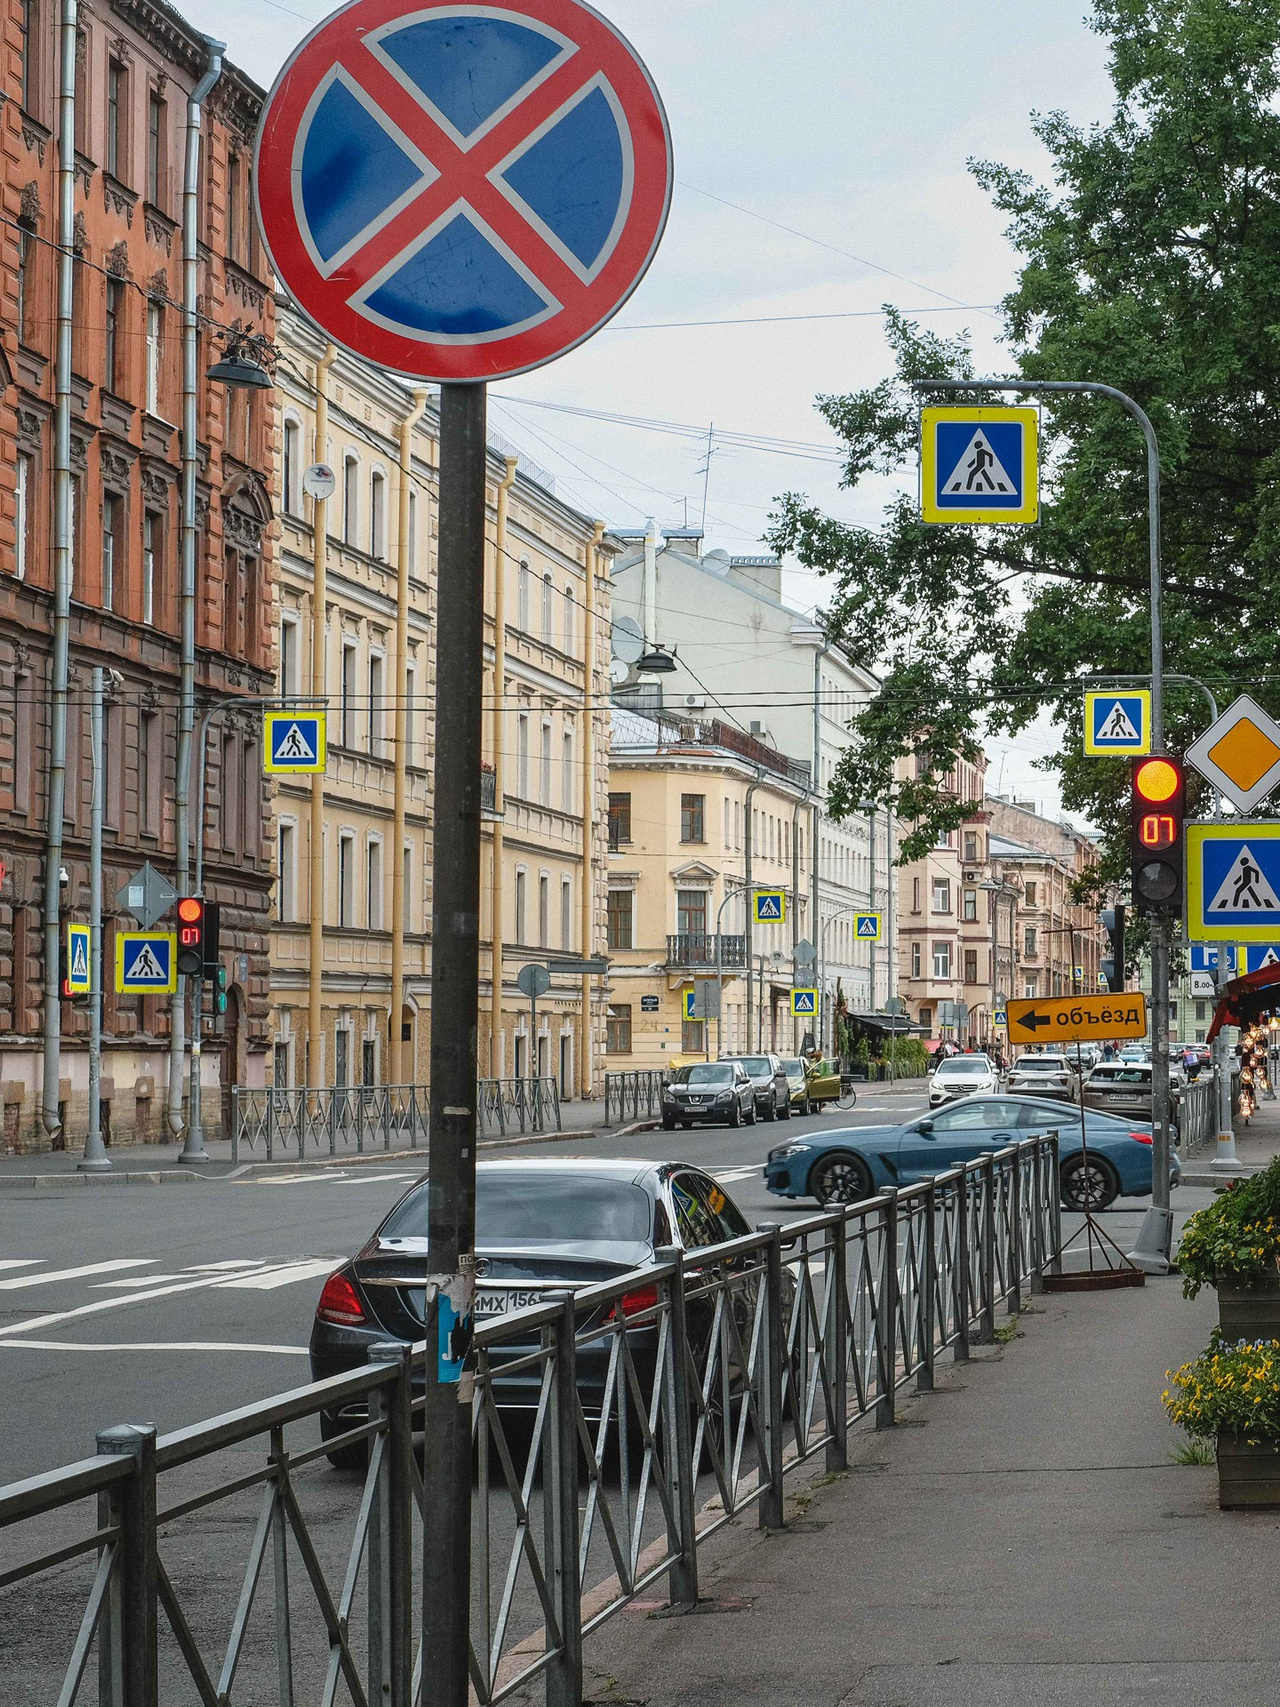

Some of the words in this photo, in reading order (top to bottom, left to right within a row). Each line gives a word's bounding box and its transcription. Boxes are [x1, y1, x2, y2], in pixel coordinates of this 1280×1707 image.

[1144, 816, 1174, 843] 07
[182, 928, 199, 944] 07
[1056, 1006, 1140, 1026] объёзд
